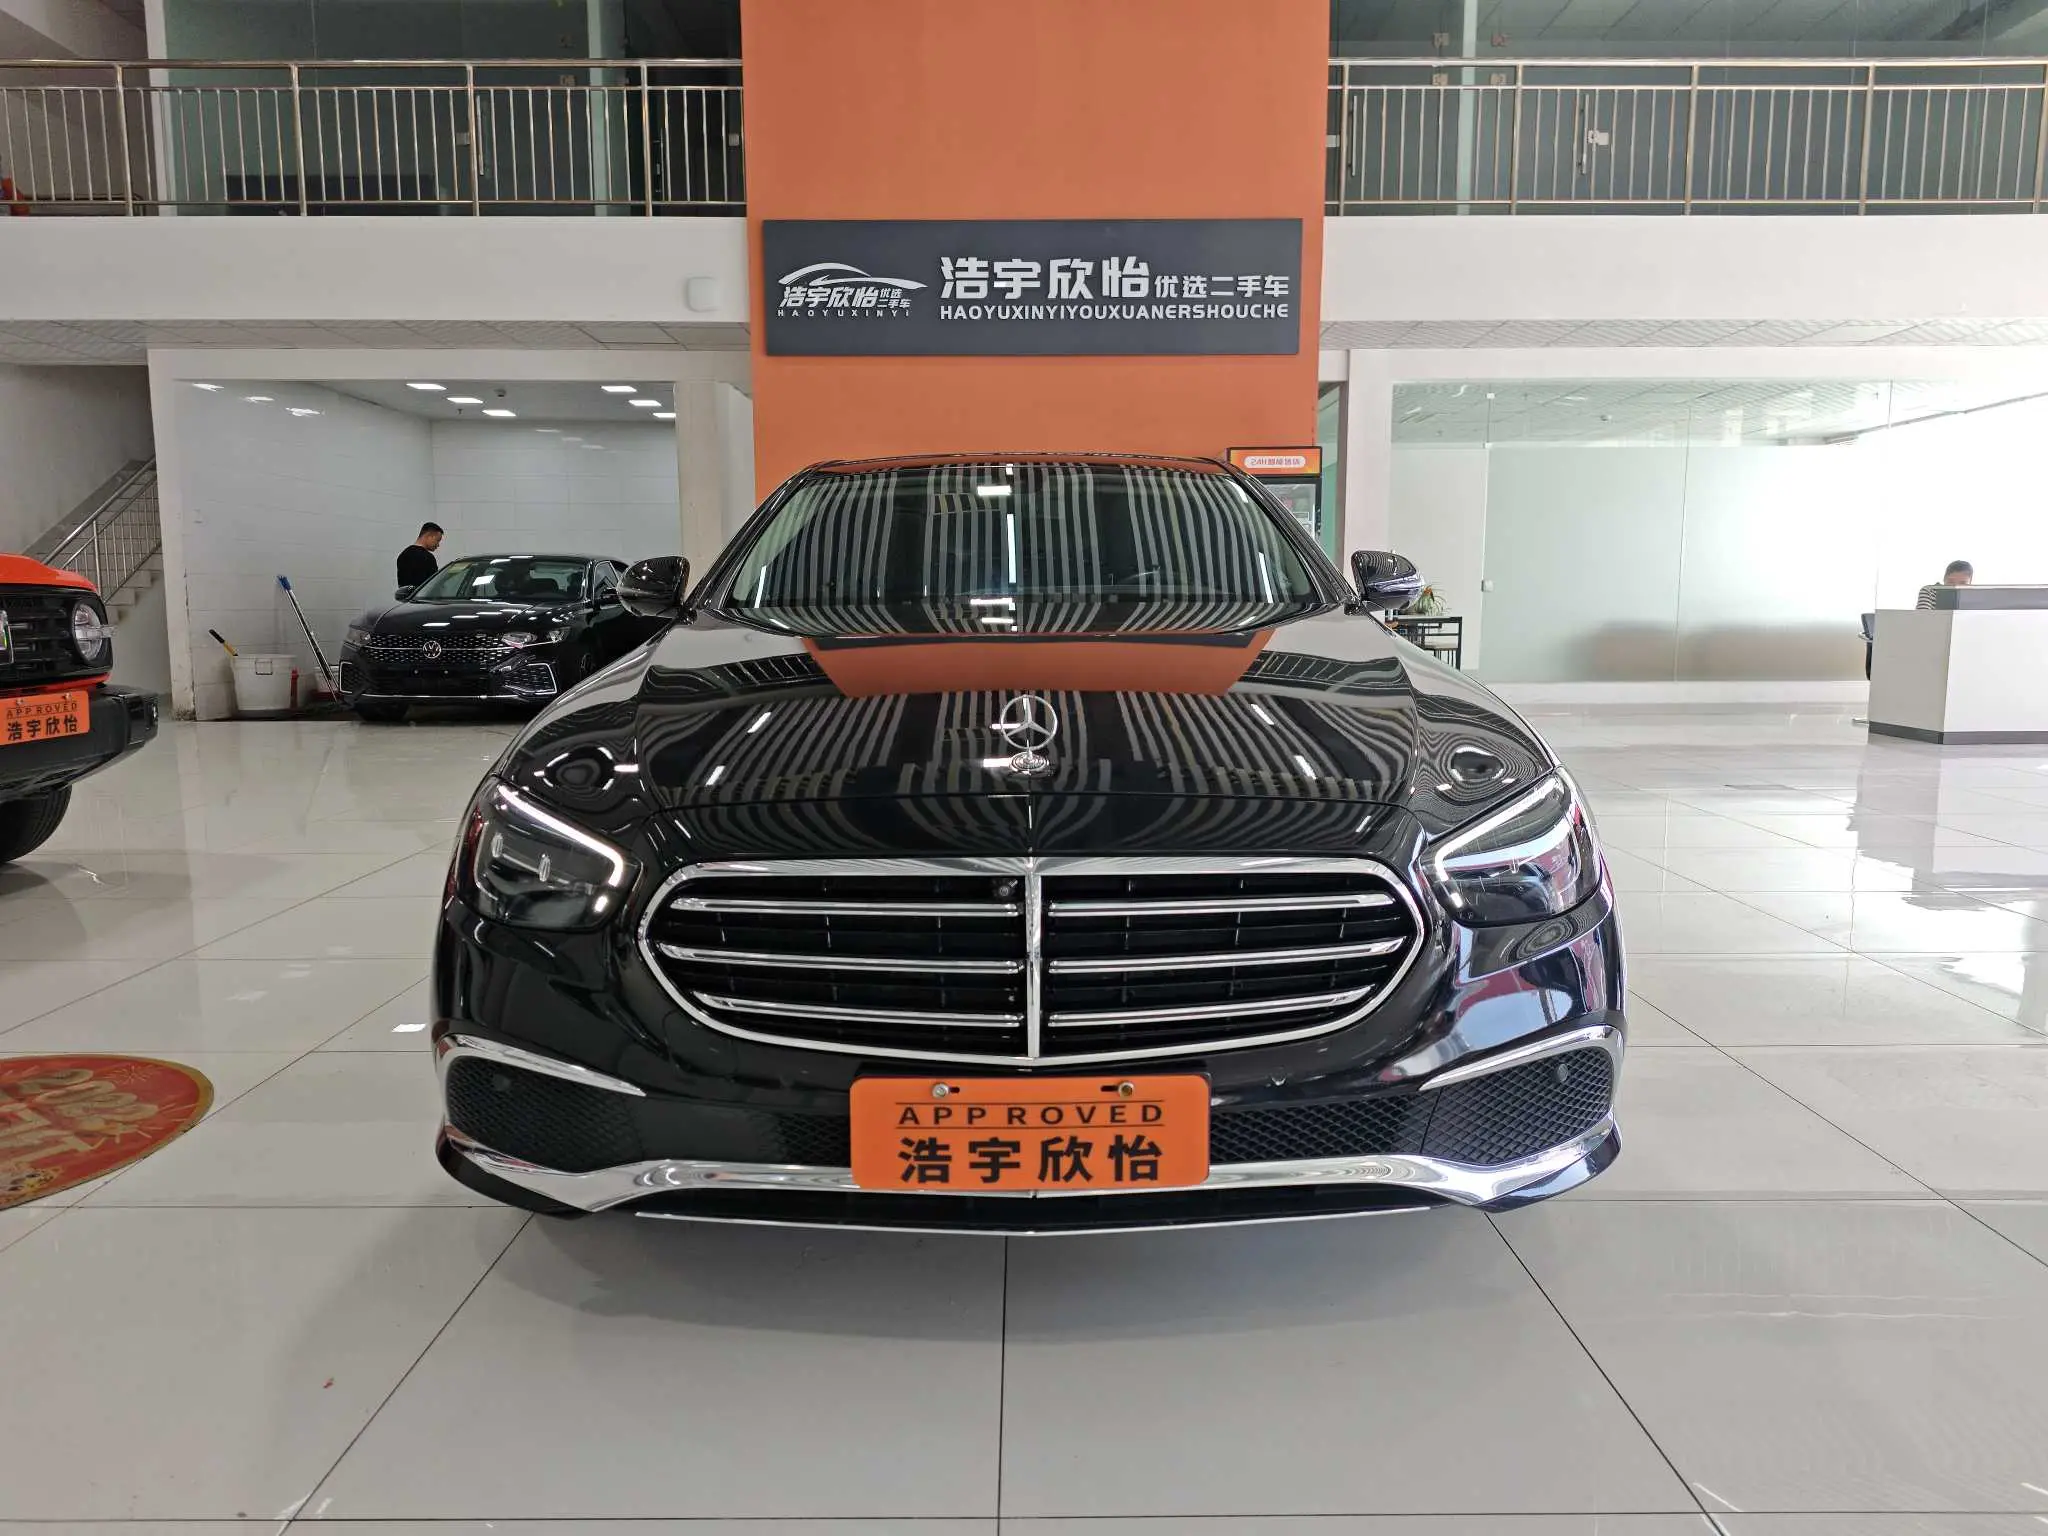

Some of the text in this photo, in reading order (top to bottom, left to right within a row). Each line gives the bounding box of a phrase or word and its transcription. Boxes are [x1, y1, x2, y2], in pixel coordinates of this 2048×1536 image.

[940, 256, 1290, 299] 浩宇欣怡 优选二手车
[779, 286, 902, 308] 浩宇欣怡 优选
[877, 298, 912, 309] 二手车
[940, 303, 1290, 320] HAOYUXINYIYOUXUANERSHOUCHE
[6, 701, 78, 719] APPROVED
[7, 713, 79, 741] 浩宇欣怡
[898, 1104, 1163, 1126] APPROVED
[897, 1134, 1163, 1184] 浩宇欣怡
